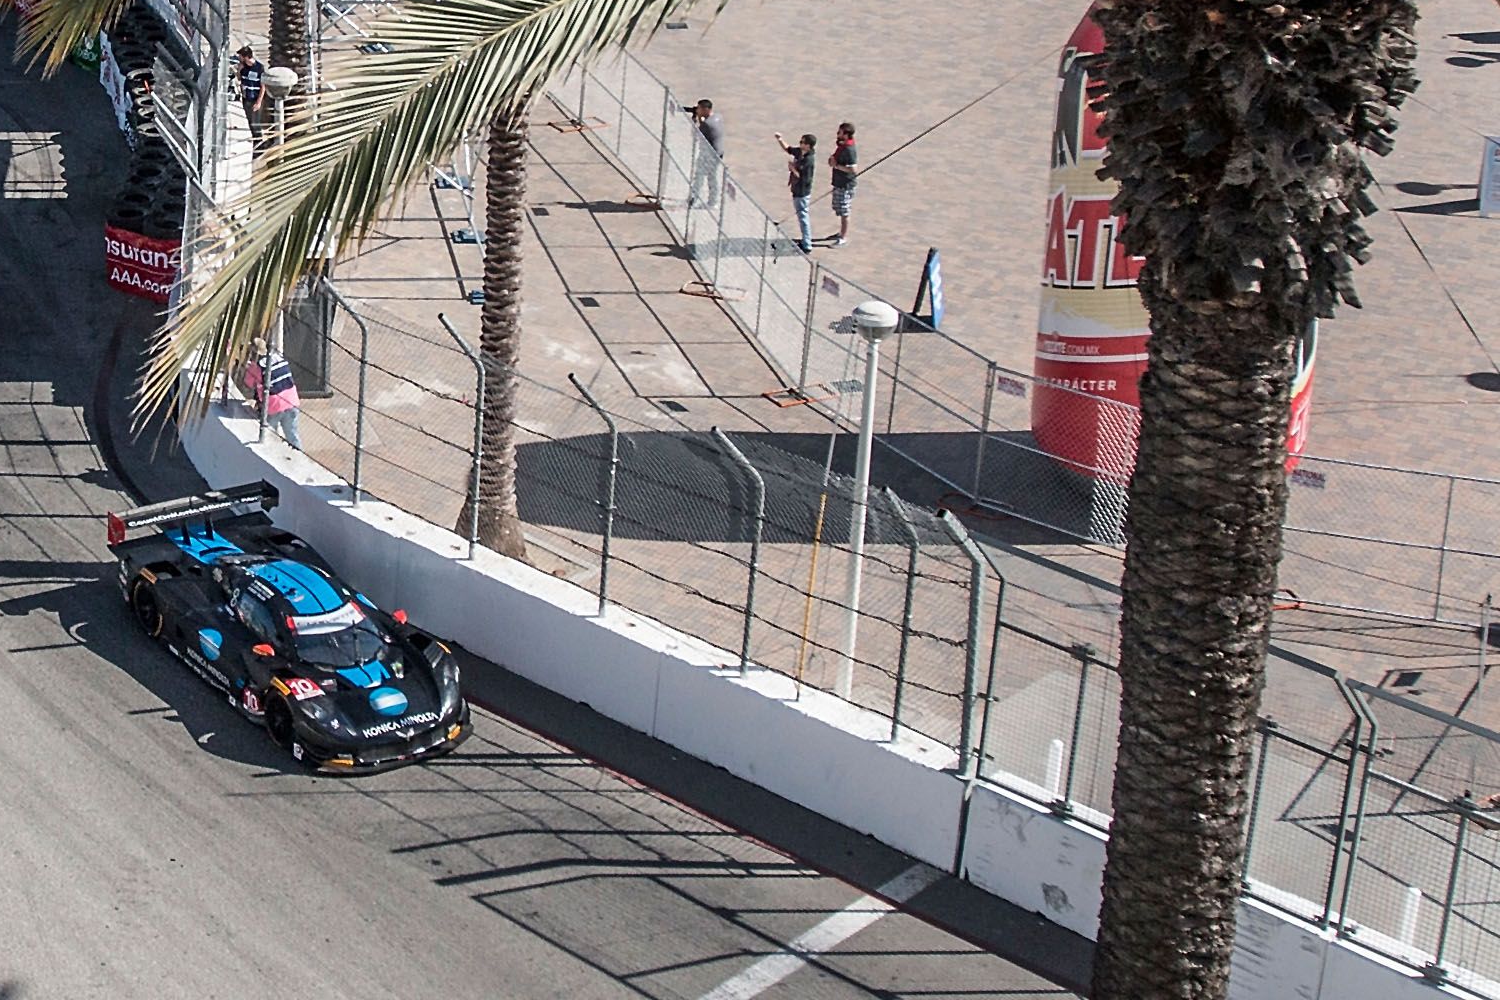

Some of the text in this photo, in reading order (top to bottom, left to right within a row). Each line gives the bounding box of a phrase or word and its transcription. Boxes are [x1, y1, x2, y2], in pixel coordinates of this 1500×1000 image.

[290, 679, 313, 695] 10
[244, 690, 258, 711] 10
[362, 711, 439, 739] KONICA MINOLTA
